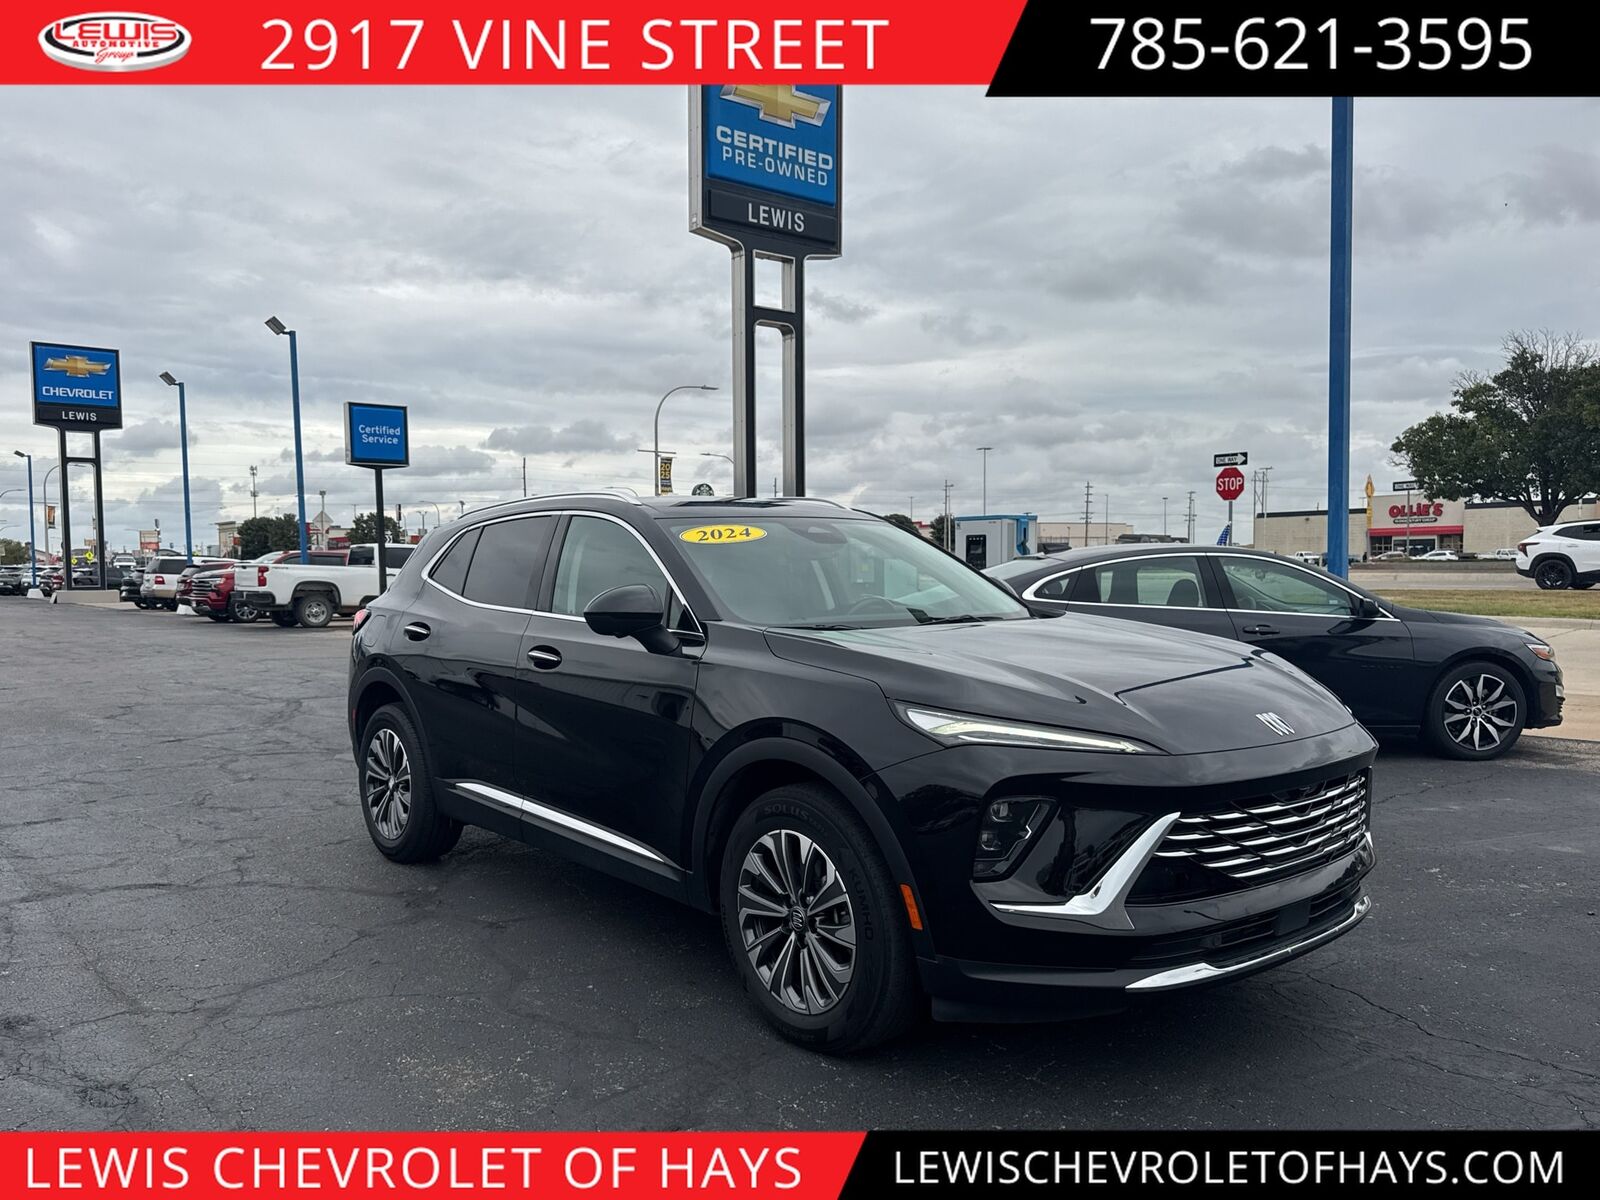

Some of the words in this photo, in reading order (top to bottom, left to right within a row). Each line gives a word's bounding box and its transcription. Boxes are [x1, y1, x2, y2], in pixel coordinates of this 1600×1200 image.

[716, 125, 833, 170] CERTIFIED
[722, 146, 828, 186] PRE-OWNED
[748, 203, 805, 232] LEWIS
[42, 386, 114, 400] CHEVROLET
[62, 411, 97, 421] LEWIS
[358, 424, 401, 435] Certified
[361, 434, 399, 444] Service
[1217, 477, 1243, 490] STOP
[1389, 503, 1444, 518] OLLIE'S
[696, 527, 751, 541] 2024
[764, 803, 809, 820] SOLUS
[850, 869, 874, 941] KUMHO
